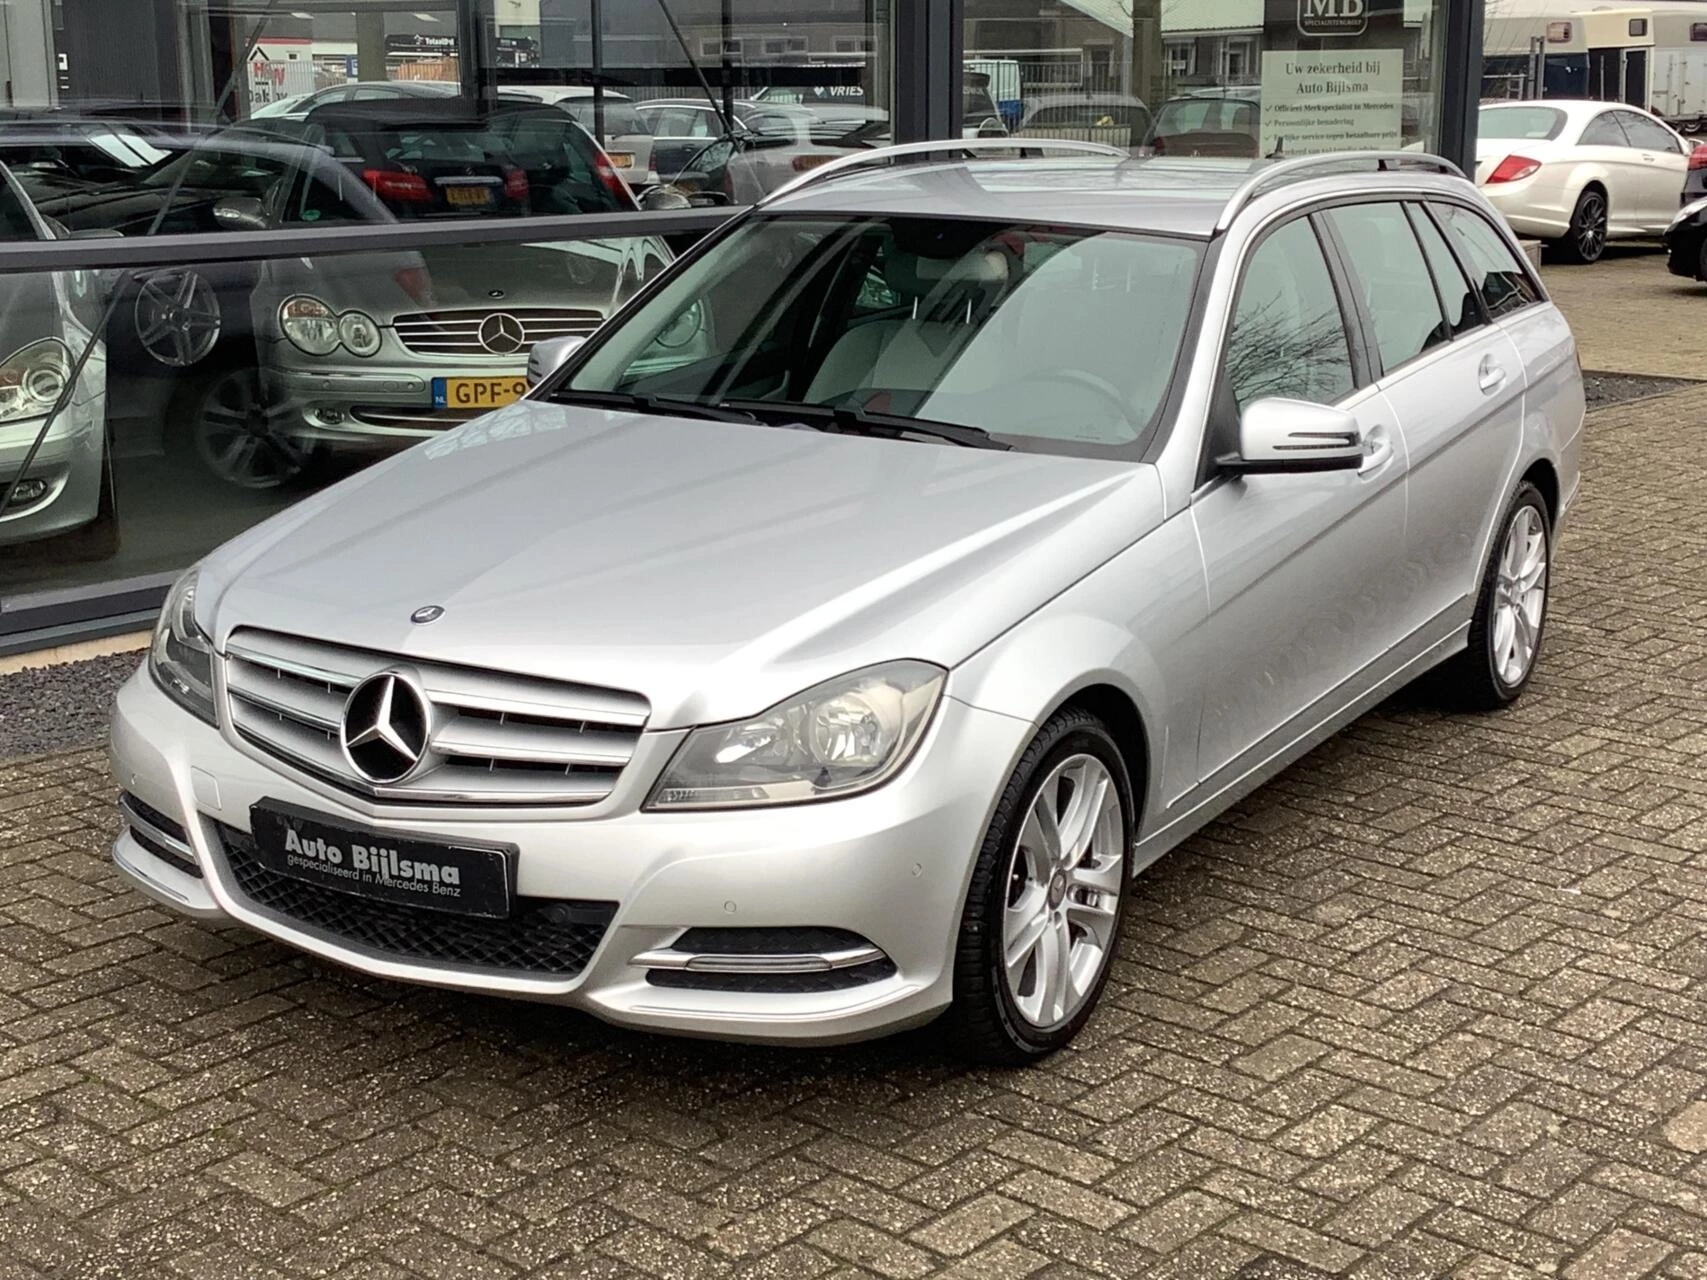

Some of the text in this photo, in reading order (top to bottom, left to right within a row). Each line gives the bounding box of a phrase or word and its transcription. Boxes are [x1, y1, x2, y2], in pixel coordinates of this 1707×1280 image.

[1285, 61, 1381, 75] Uw zekerheid bij
[830, 86, 864, 96] VRIES
[1296, 81, 1369, 96] Auto Bijlsma
[1362, 102, 1394, 110] Mercedes
[456, 381, 526, 405] GPF-9
[285, 828, 461, 885] Auto Bijlsma
[287, 854, 462, 897] gespecialiseerd in Mercedes Benz
